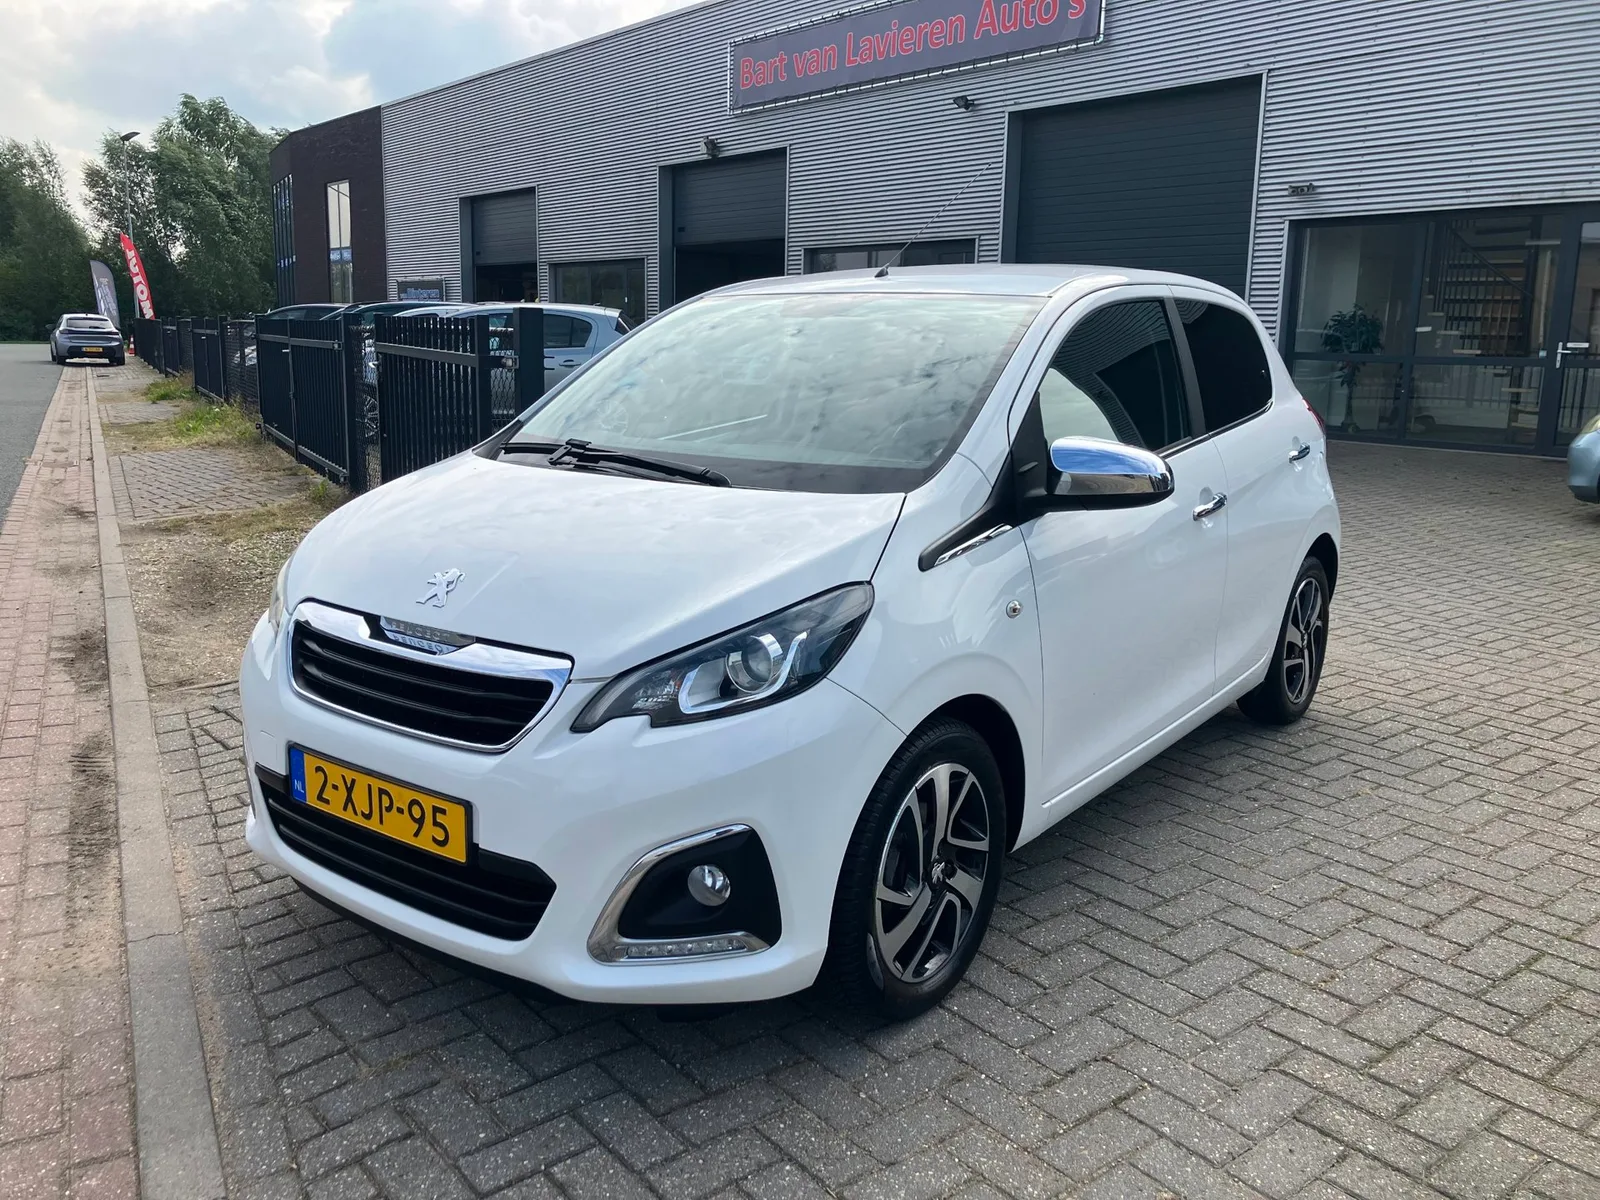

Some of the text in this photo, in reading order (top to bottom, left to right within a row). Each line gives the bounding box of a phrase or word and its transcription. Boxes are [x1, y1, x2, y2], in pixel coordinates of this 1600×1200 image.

[740, 0, 1087, 89] Bart van Lavieren Autos
[294, 779, 305, 794] NL
[314, 765, 450, 848] 2-XJP-95
